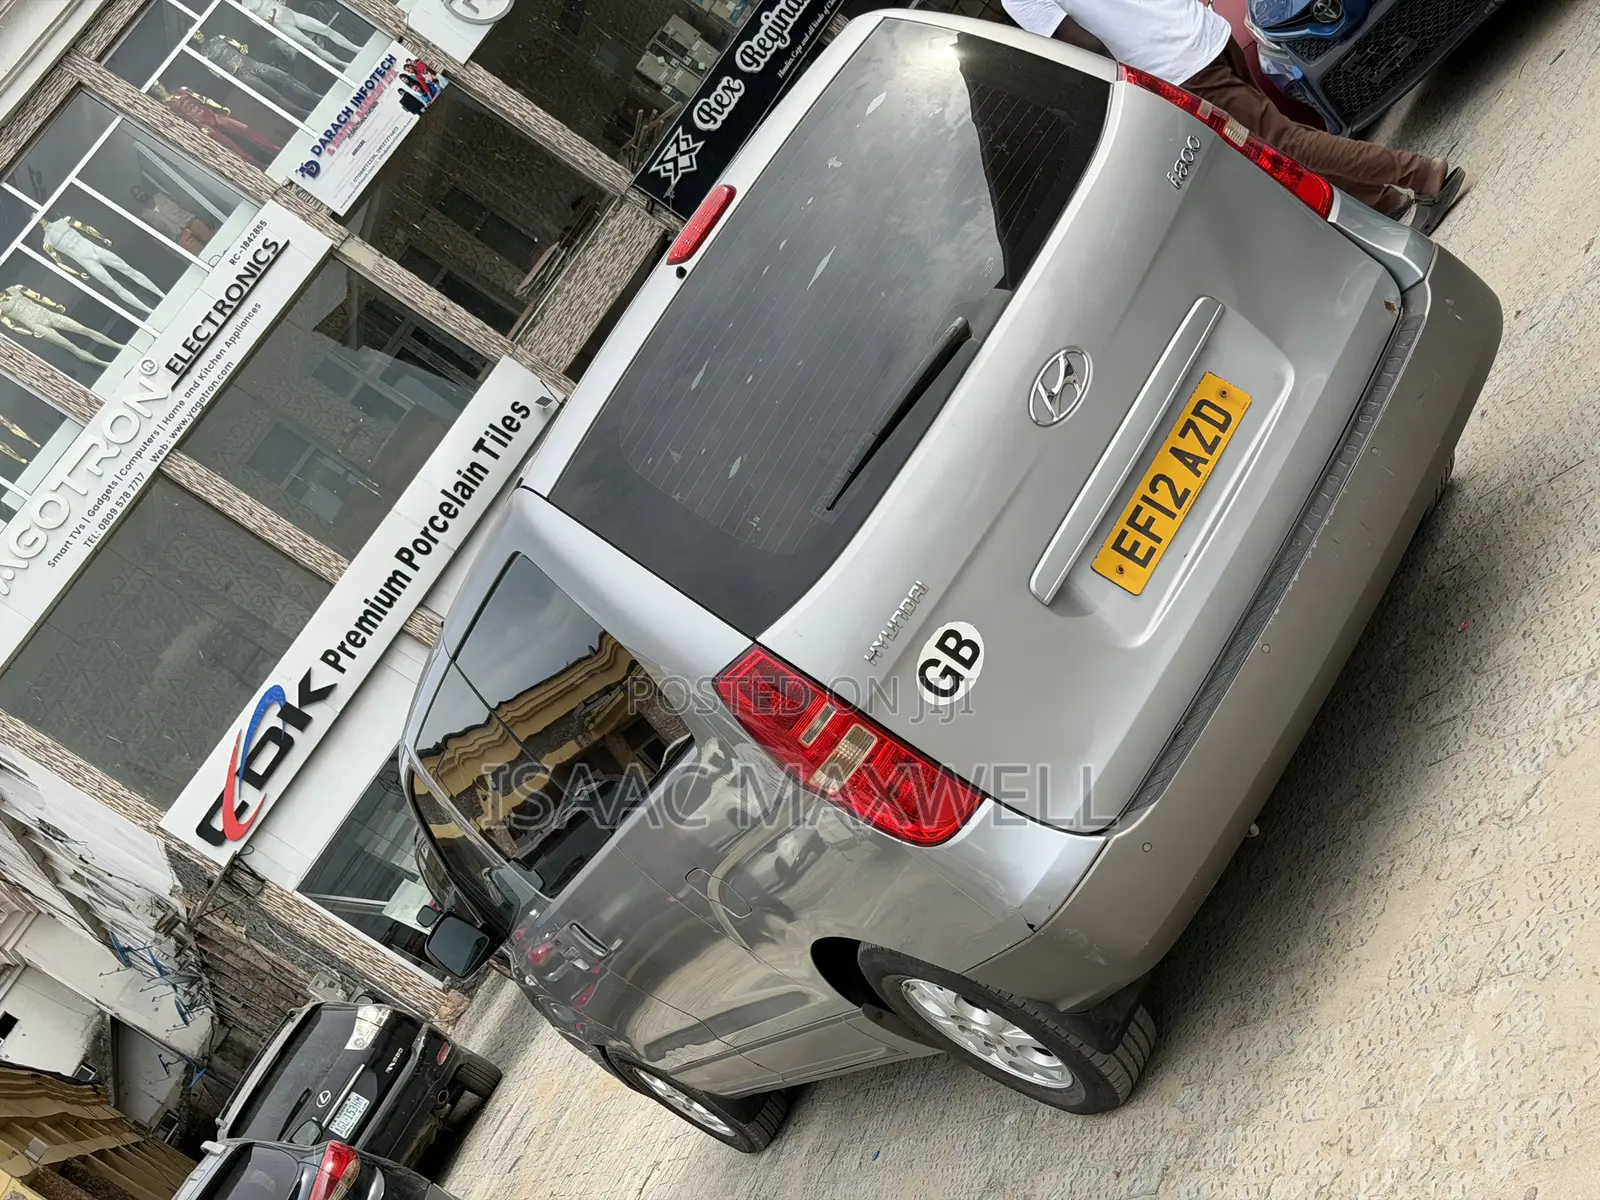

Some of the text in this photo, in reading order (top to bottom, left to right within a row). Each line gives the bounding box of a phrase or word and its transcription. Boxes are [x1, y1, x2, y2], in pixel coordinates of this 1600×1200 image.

[801, 33, 810, 46] and
[311, 106, 354, 157] DARACH
[350, 54, 396, 108] INFOTECH
[693, 76, 745, 131] Rex
[1166, 135, 1201, 190] i800
[229, 220, 267, 265] RC-1842855
[165, 238, 279, 375] ELECTRONICS
[48, 303, 261, 567] Smart TVs Gadgets Computers Home and Kitchen Appliances
[83, 531, 101, 547] TEL:
[98, 508, 118, 530] 0809
[115, 491, 131, 507] 578
[128, 472, 144, 491] 7717
[170, 362, 235, 441] www.yagotron.com
[1111, 474, 1191, 568] EF12
[1169, 399, 1232, 478] AZD
[320, 570, 412, 674] Premium
[394, 462, 489, 572] Porcelain
[472, 402, 530, 460] Tiles
[863, 579, 928, 666] HYUNDAI
[917, 627, 981, 698] GB
